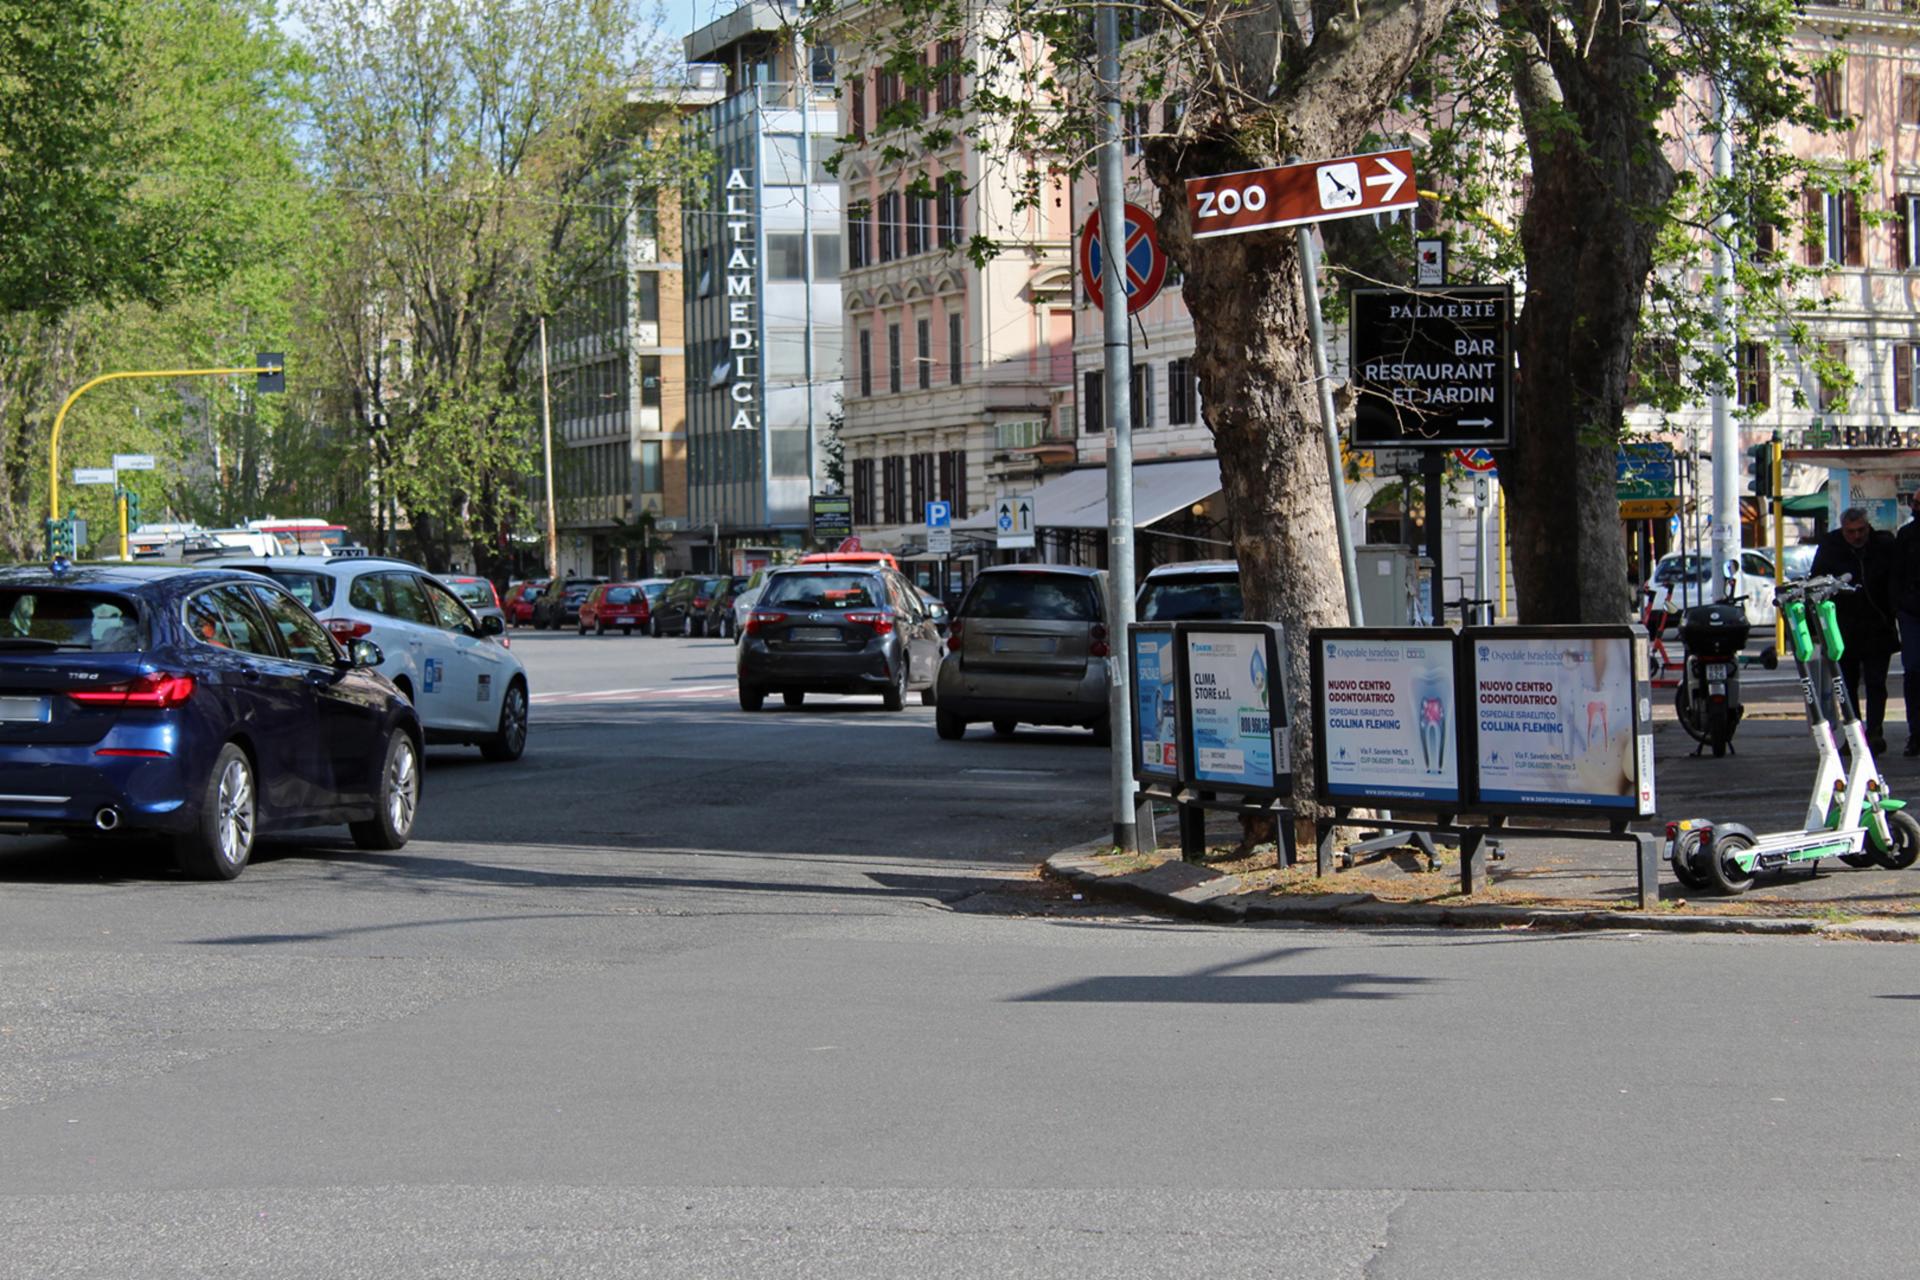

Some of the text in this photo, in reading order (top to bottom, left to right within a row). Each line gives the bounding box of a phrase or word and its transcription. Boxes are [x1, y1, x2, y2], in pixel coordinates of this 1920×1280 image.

[1195, 184, 1267, 219] ZOO
[725, 168, 754, 430] ALTAMEDICA
[1389, 303, 1496, 319] PALMERIE
[1454, 339, 1495, 356] BAR
[1365, 362, 1496, 381] RESTAURANT
[1393, 386, 1495, 404] ET JARDIN
[1491, 649, 1526, 661] Ospedale
[1194, 673, 1216, 685] CLIMA
[1328, 680, 1391, 691] NUOVO CENTRO
[1479, 681, 1553, 693] NUOVO CENTRO
[1195, 687, 1217, 700] STORE
[1328, 693, 1395, 703] ODONTOIATRICO
[1480, 694, 1558, 706] ODONTOIATRICO
[1329, 708, 1394, 718] OSPEDALE ISRAELITICO
[1480, 709, 1557, 720] OSPEDALE ISRAELITICO
[1330, 719, 1401, 730] COLLINA FLEMING
[1480, 721, 1564, 734] COLLINA FLEMING
